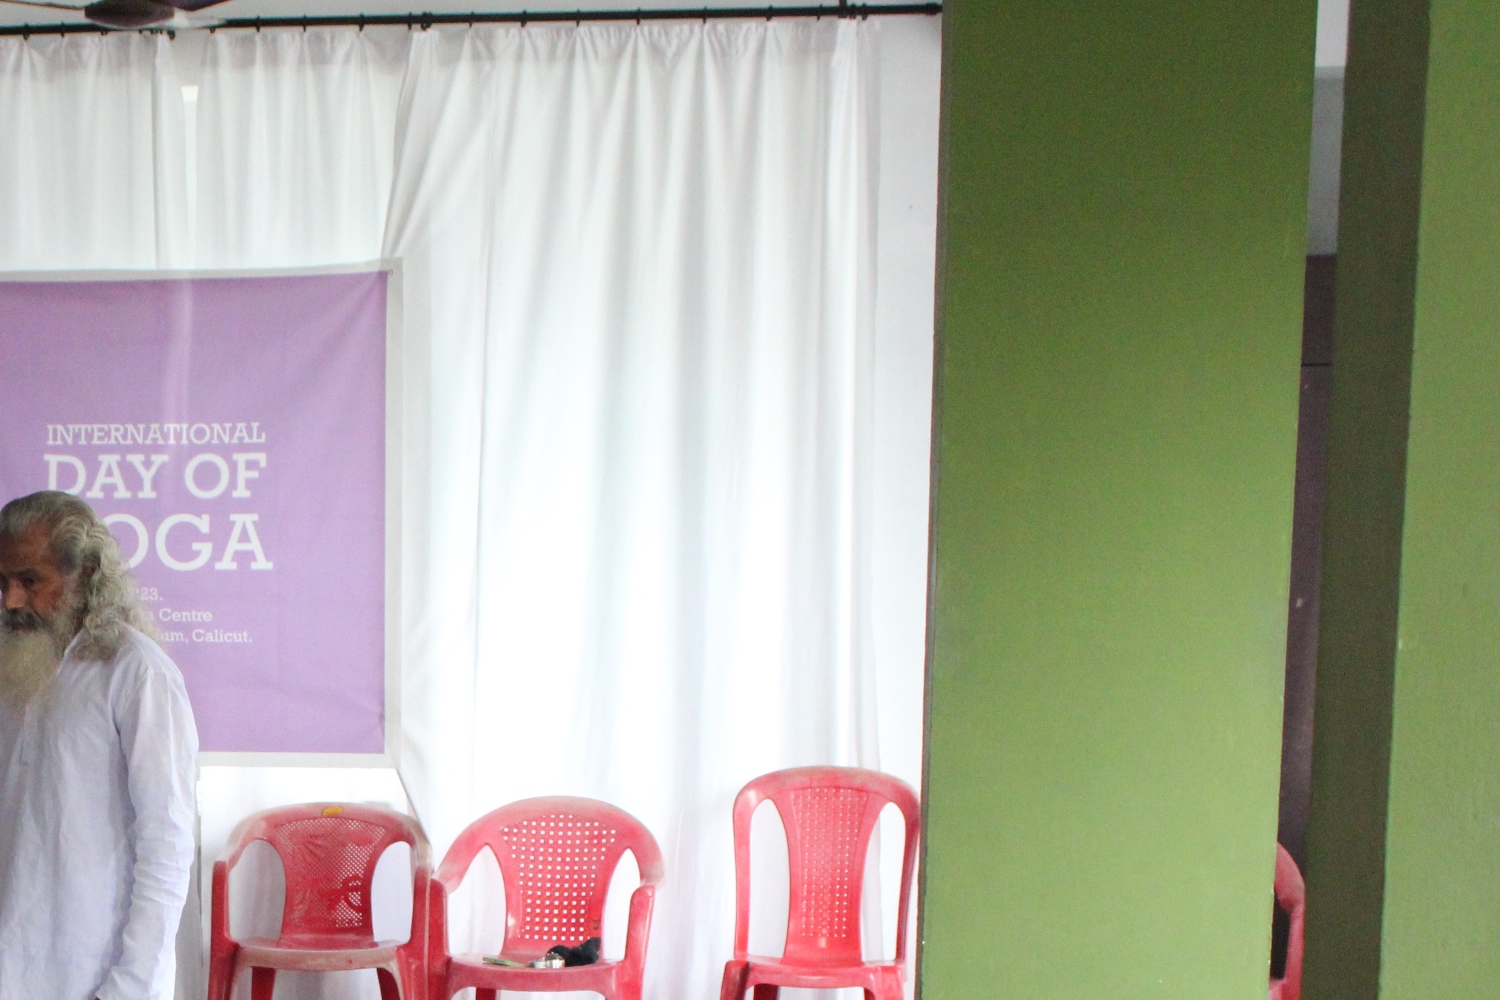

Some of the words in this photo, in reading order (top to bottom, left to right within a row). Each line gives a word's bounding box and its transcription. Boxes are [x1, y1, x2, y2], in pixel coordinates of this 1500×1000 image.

[46, 422, 266, 445] INTERNATIONAL
[44, 453, 169, 499] DAY
[184, 452, 267, 499] OF
[102, 513, 274, 572] OGA
[159, 608, 213, 622] Centre
[192, 629, 252, 643] Calicut.
